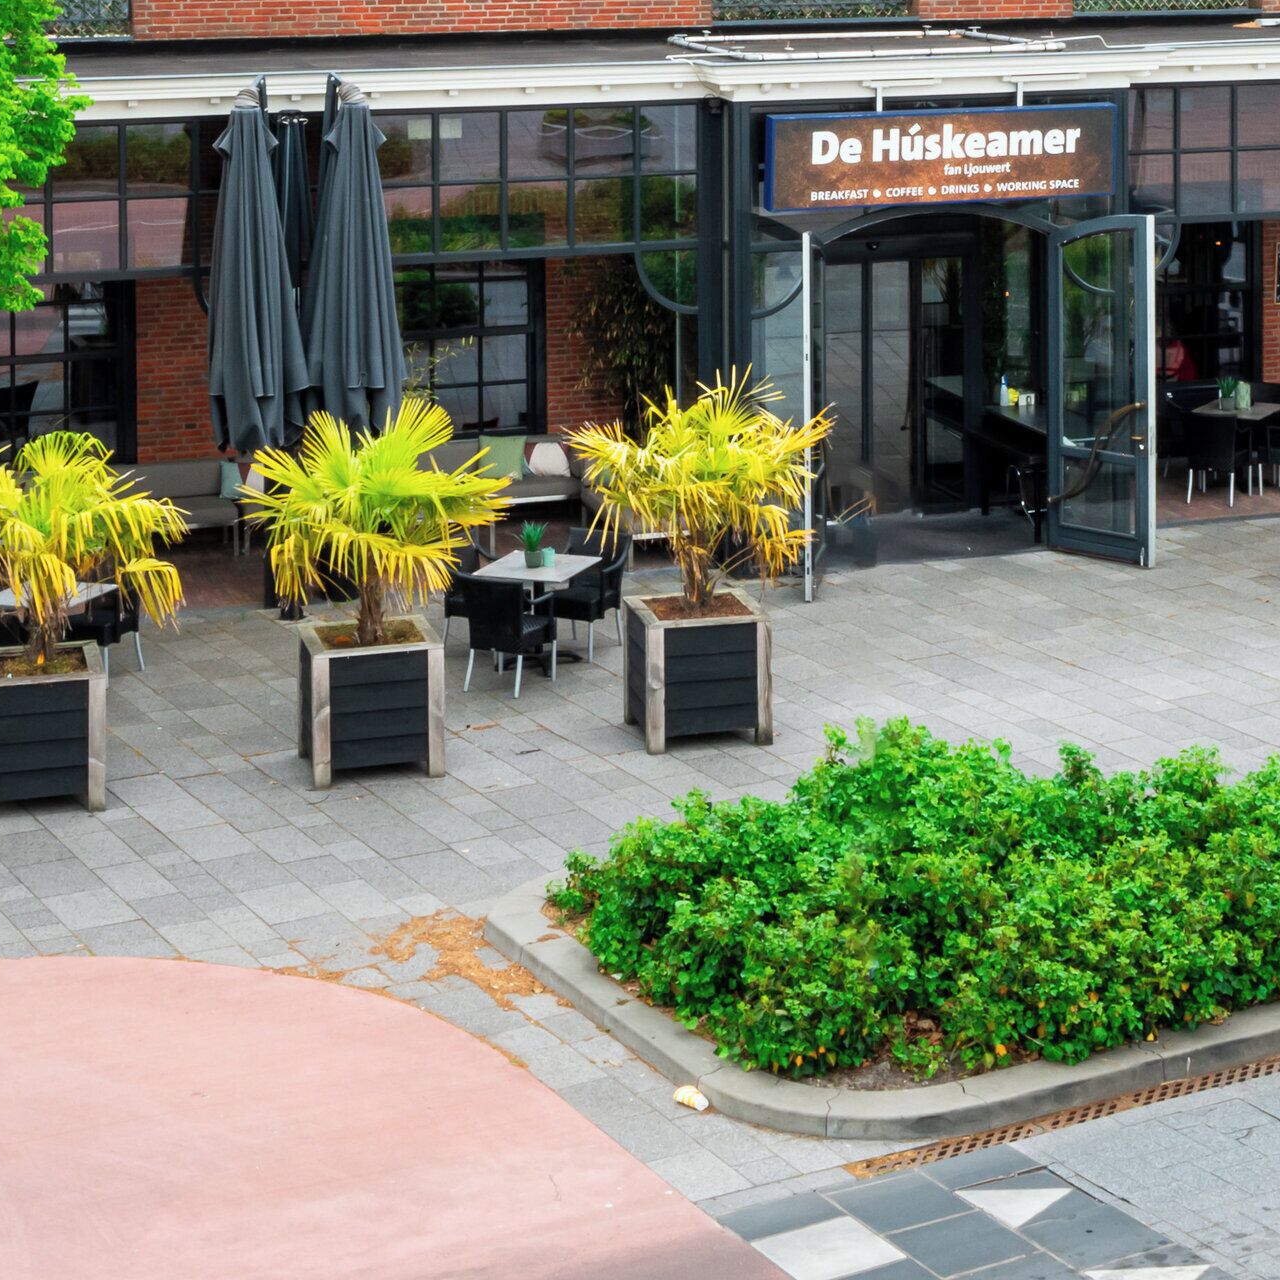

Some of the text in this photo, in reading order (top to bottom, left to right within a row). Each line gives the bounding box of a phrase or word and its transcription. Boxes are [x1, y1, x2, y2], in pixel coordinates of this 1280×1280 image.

[811, 123, 1081, 165] De Húskeamer
[943, 162, 1011, 177] fan Ljouwert
[810, 179, 1080, 202] BREAKFAST COFFEE DRINKS WORKING SPACE
